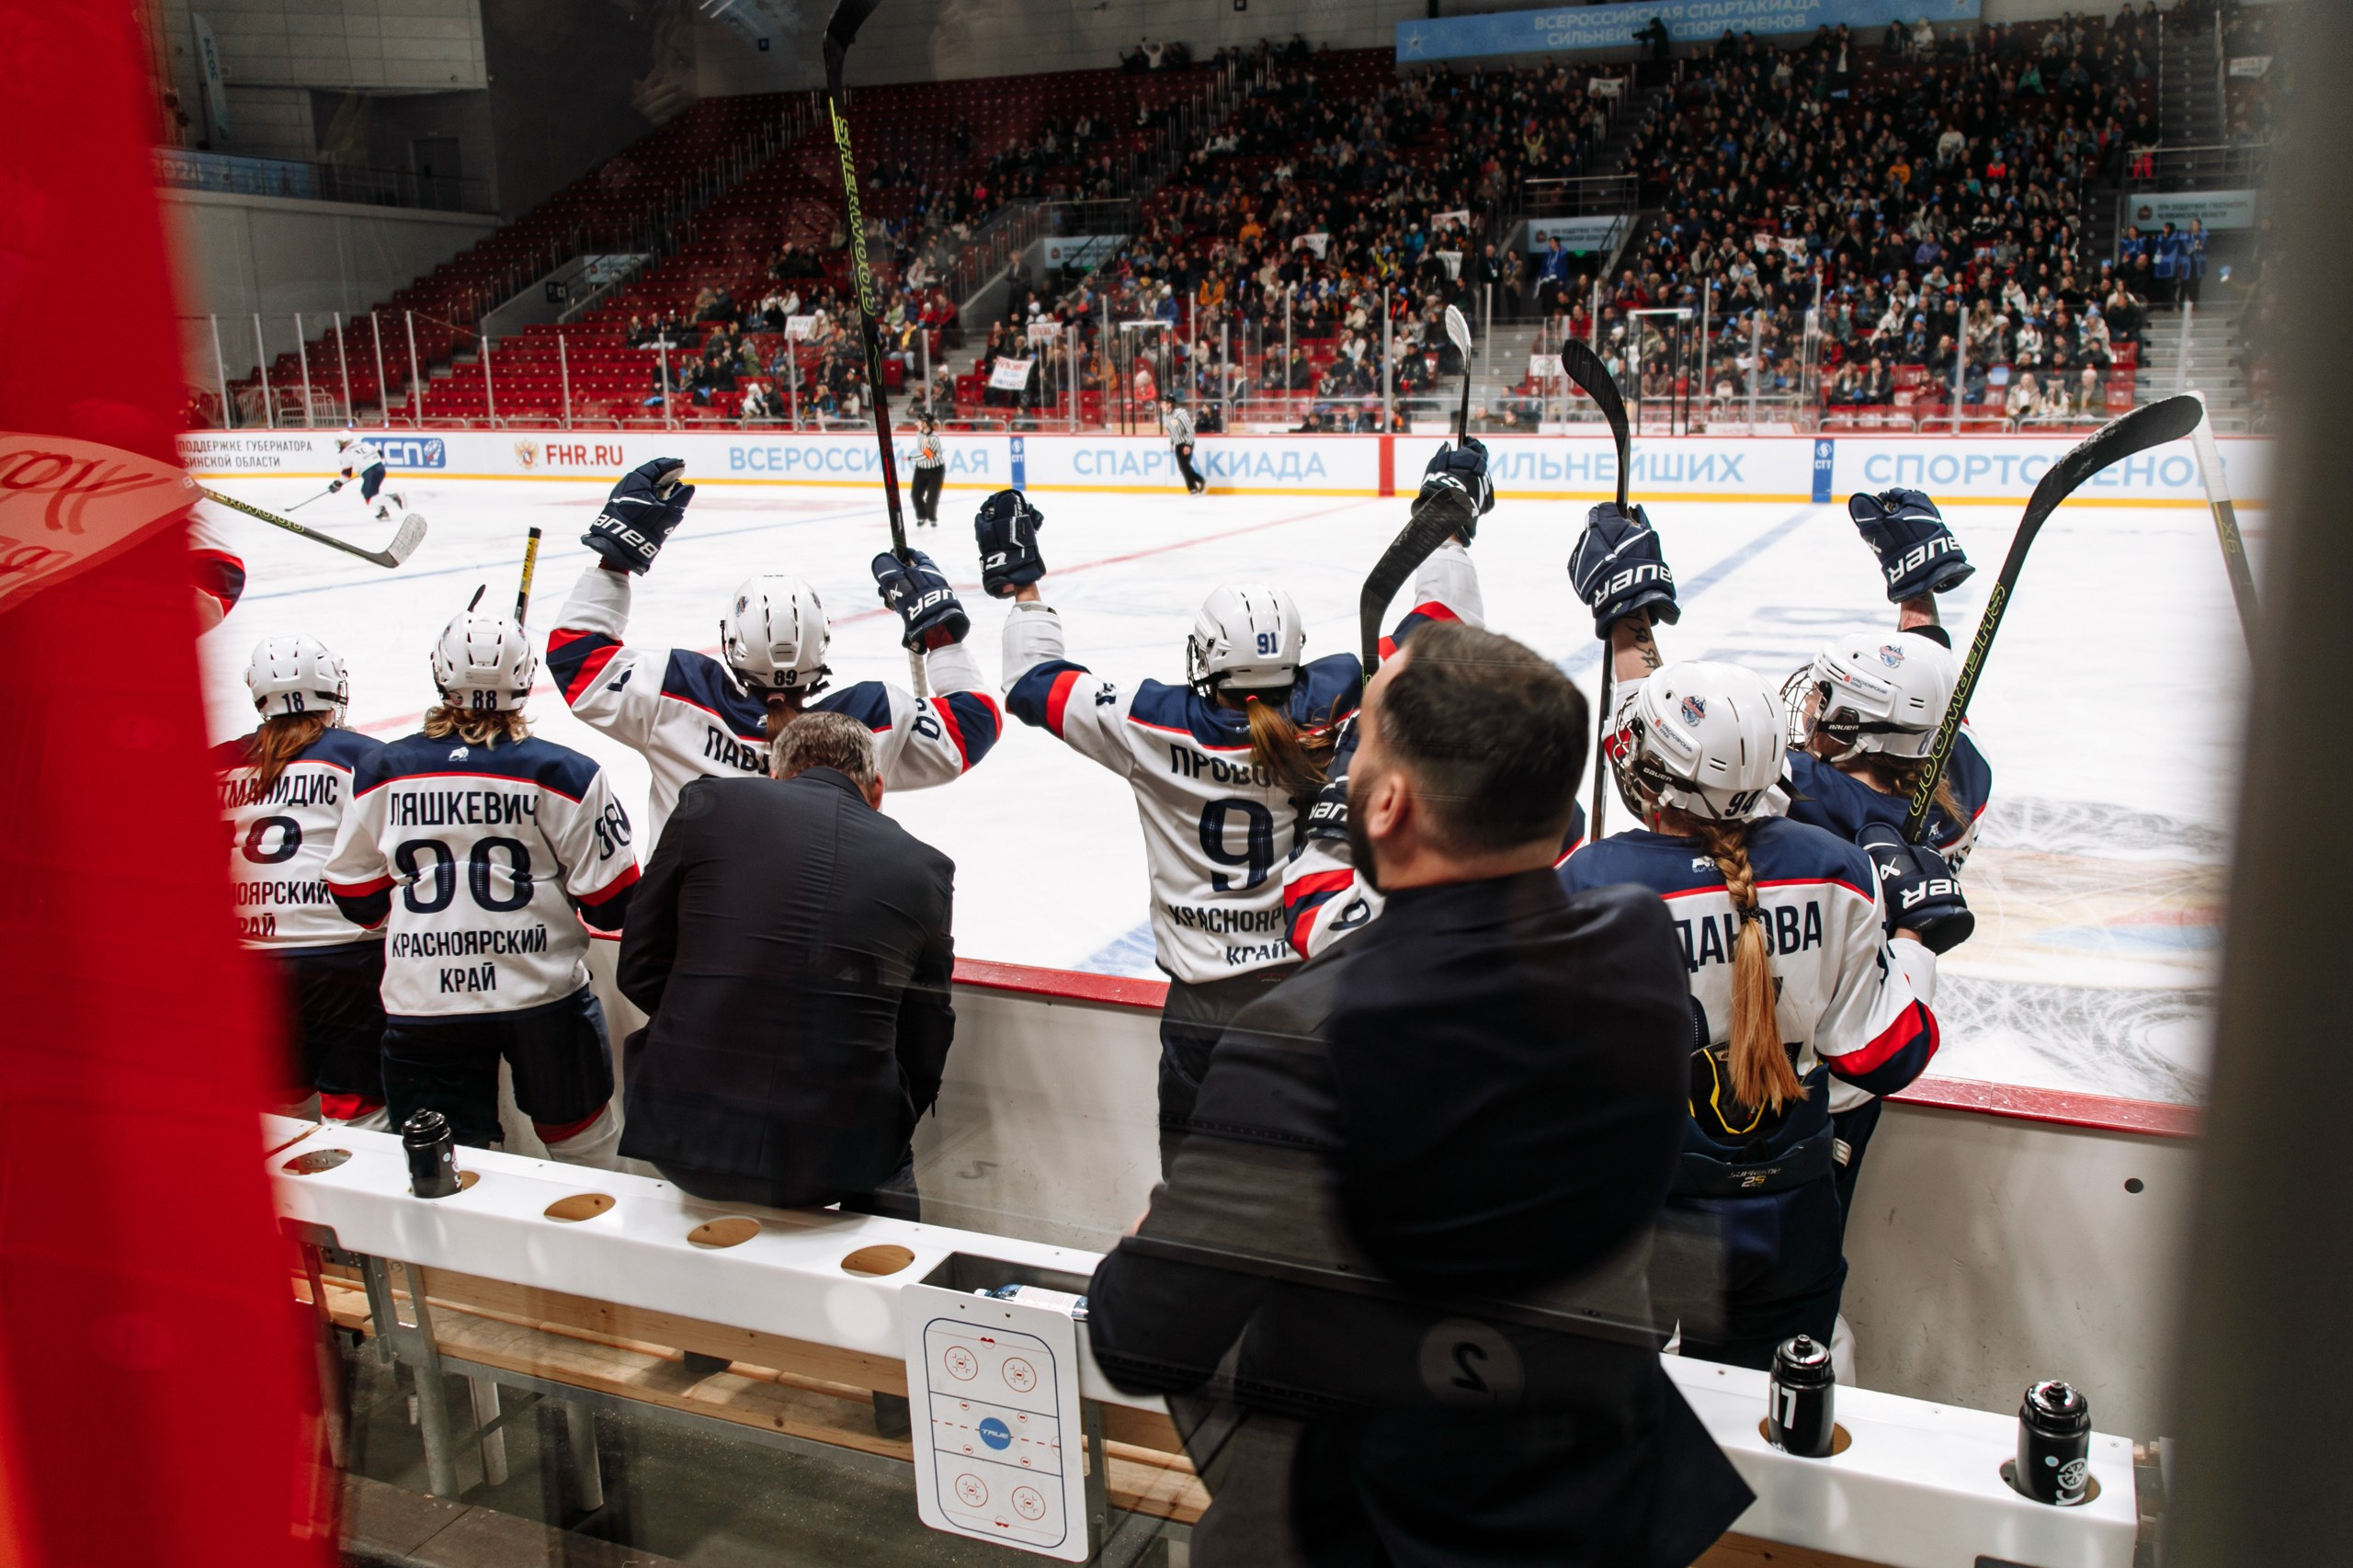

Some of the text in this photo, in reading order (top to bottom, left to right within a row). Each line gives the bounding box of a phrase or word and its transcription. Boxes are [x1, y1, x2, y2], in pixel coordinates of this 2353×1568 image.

[1672, 14, 1806, 37] СПОРТСМЕНОВ
[835, 115, 875, 317] SHERWOOD
[179, 440, 313, 453] ПОДДЕРЖКЕ ГУБЕРНАТОРА
[546, 444, 622, 466] FHR.RU
[235, 457, 280, 468] ОБЛАСТИ
[1486, 446, 1746, 483] ИЛЬНЕЙШИХ
[1256, 632, 1279, 655] 91
[773, 669, 798, 686] 89
[281, 691, 305, 713] 18
[472, 690, 497, 710] 88
[1909, 581, 2006, 816] SHERWOOD
[1169, 744, 1273, 788] ПРОВО
[218, 774, 338, 810] ТМАНИДИС
[1724, 789, 1763, 817] 94
[390, 790, 540, 826] ЛЯШКЕВИЧ
[233, 879, 331, 906] ОЯРСКИЙ
[237, 913, 276, 937] РАЙ
[1168, 903, 1288, 934] КРАСНОЯР
[392, 924, 548, 958] КРАСНОЯРСКИЙ
[1676, 900, 1823, 974] ДАНОВА
[439, 961, 496, 994] КРАЙ
[981, 1427, 1010, 1440] TRUE
